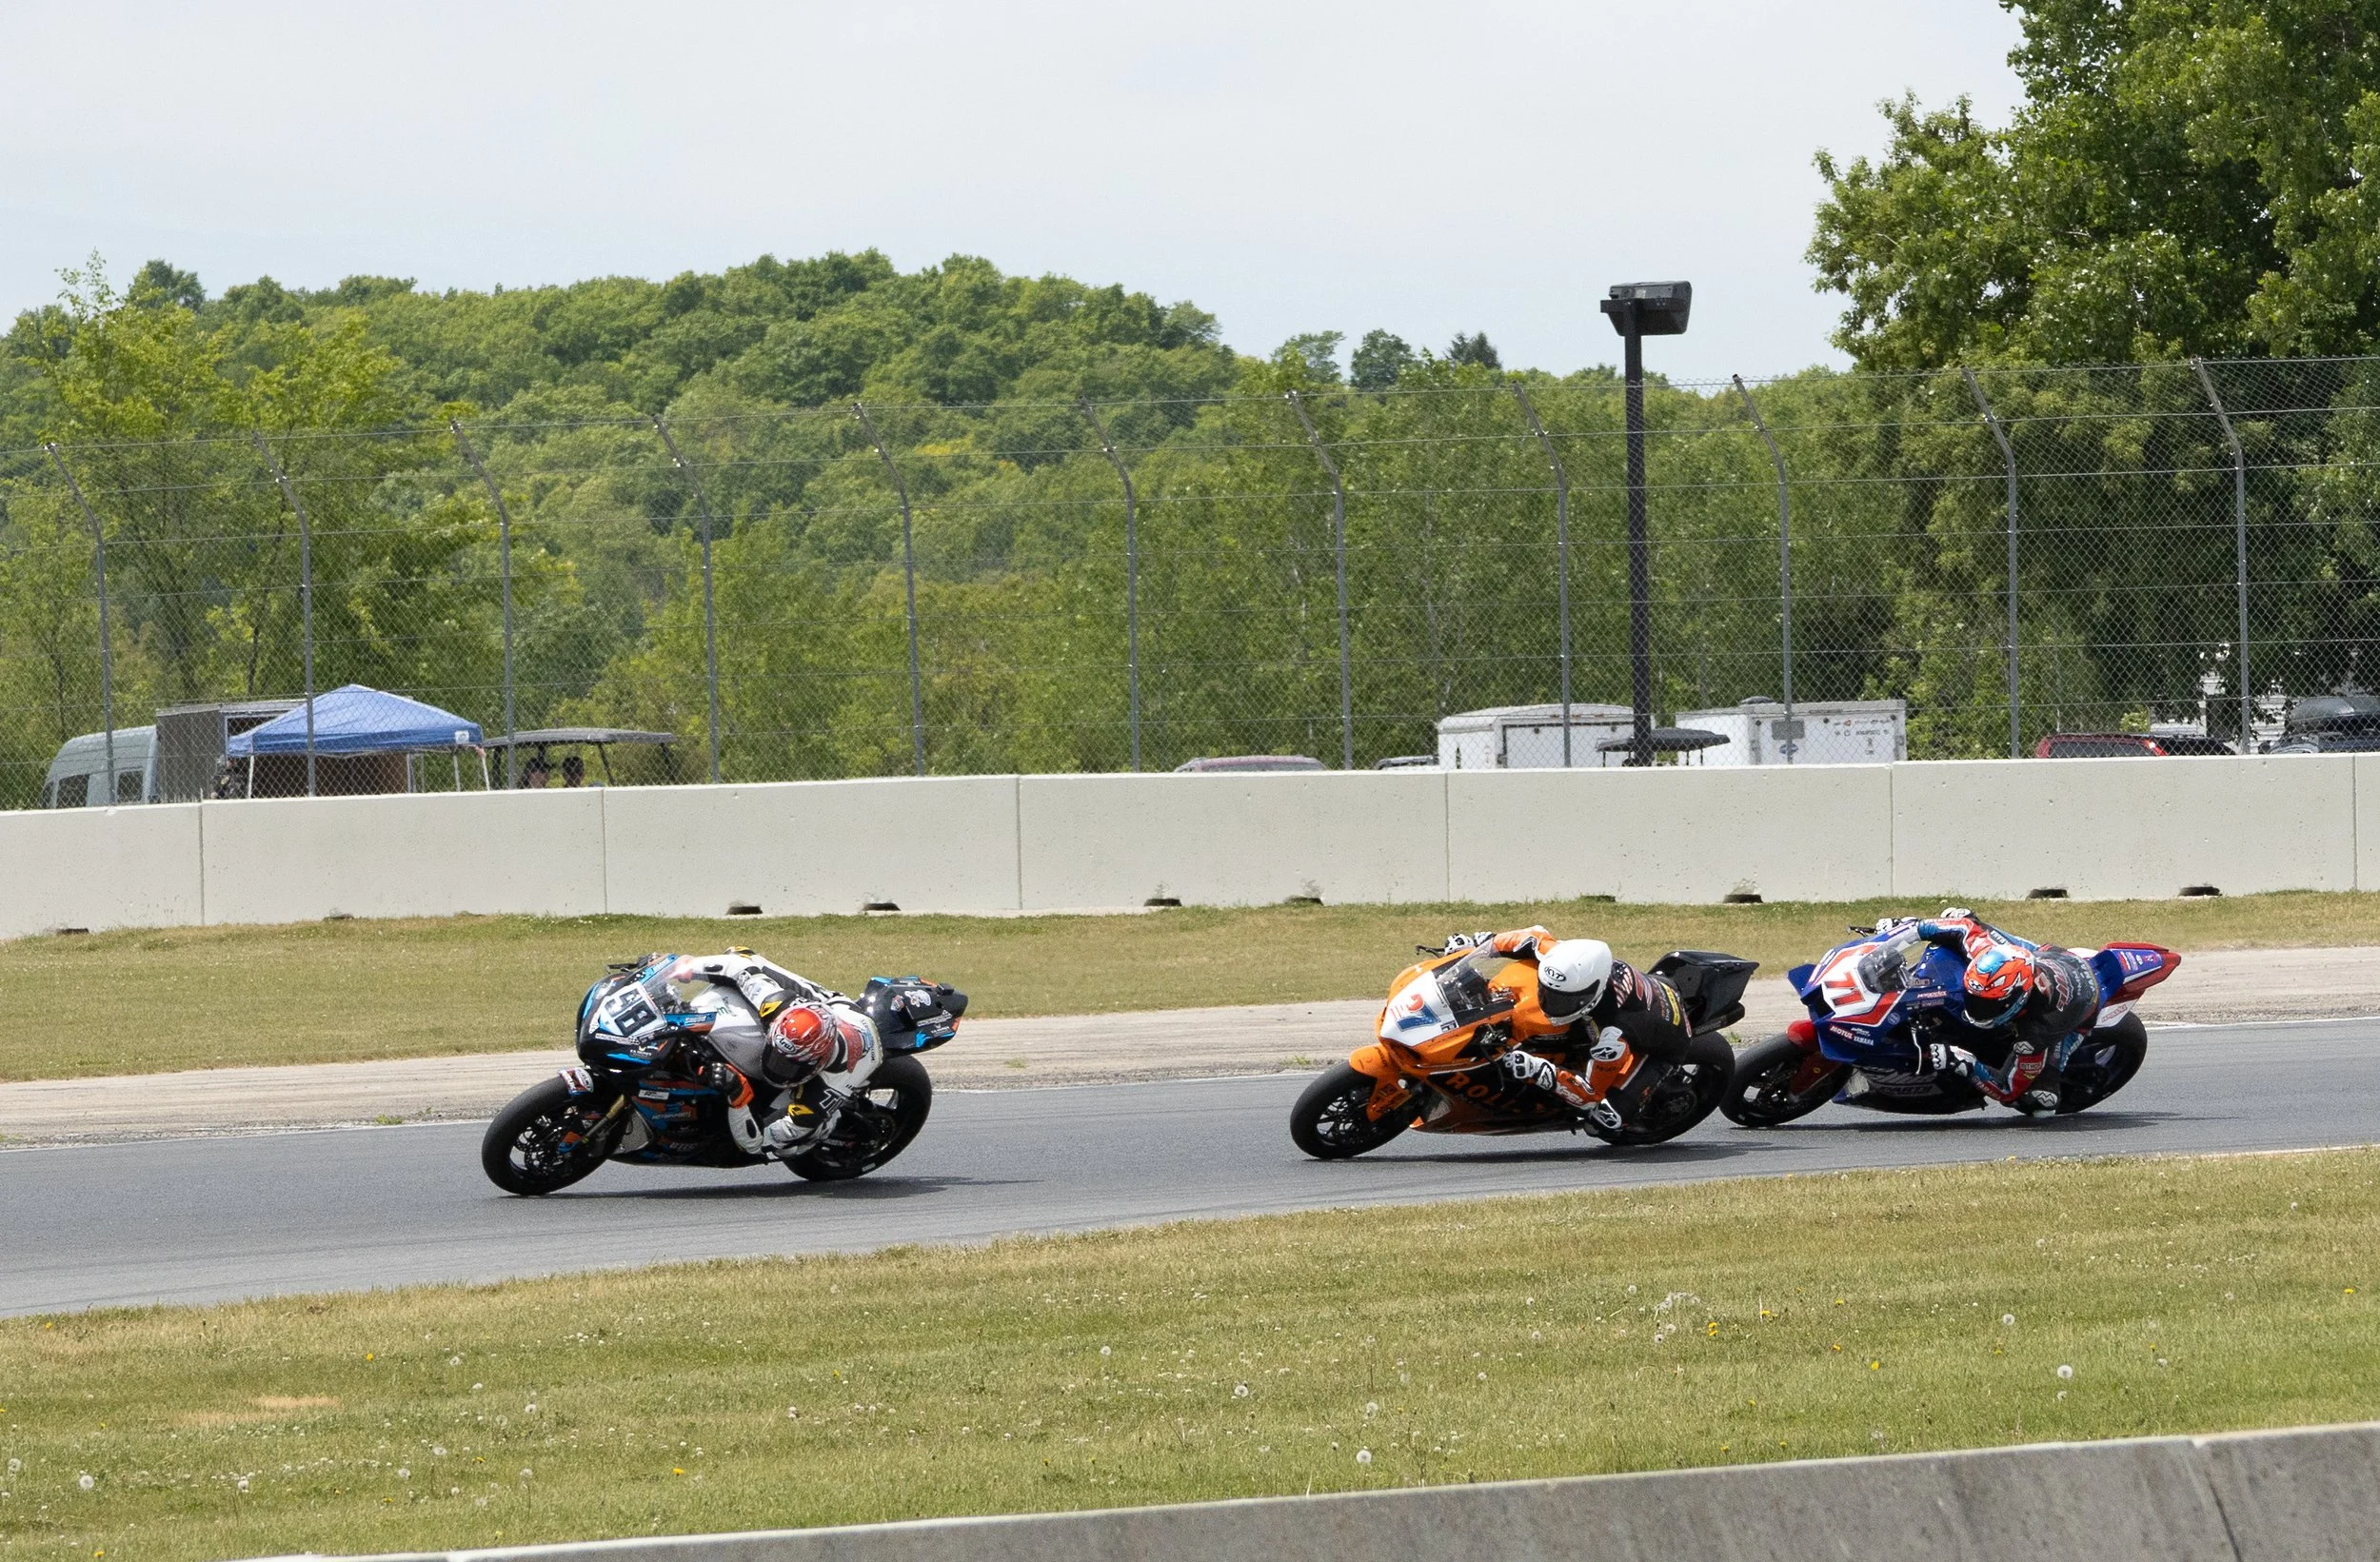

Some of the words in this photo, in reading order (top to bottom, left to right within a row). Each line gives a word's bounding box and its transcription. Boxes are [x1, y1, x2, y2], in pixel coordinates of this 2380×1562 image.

[1545, 967, 1564, 980] KYT
[1830, 1026, 1854, 1039] MOTUL
[776, 1034, 796, 1053] Arai
[1854, 1036, 1874, 1046] YAMAHA
